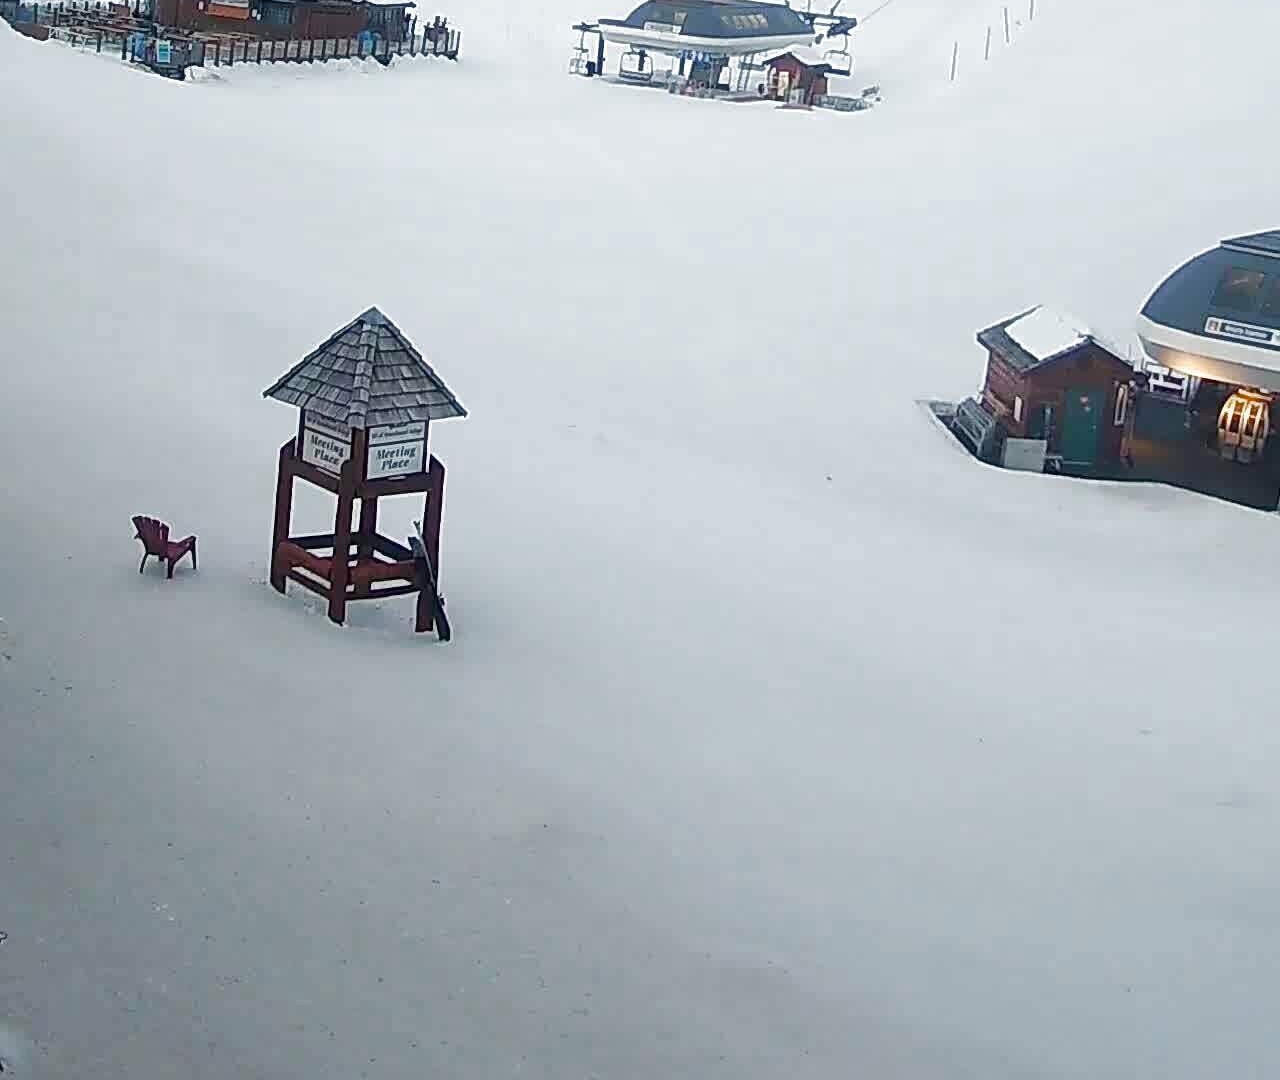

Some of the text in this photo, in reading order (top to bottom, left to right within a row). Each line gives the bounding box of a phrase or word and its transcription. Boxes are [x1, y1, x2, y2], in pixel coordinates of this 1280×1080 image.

[310, 434, 345, 458] Meeting
[376, 445, 417, 460] Meeting
[314, 448, 340, 465] Place
[381, 458, 410, 471] Place
